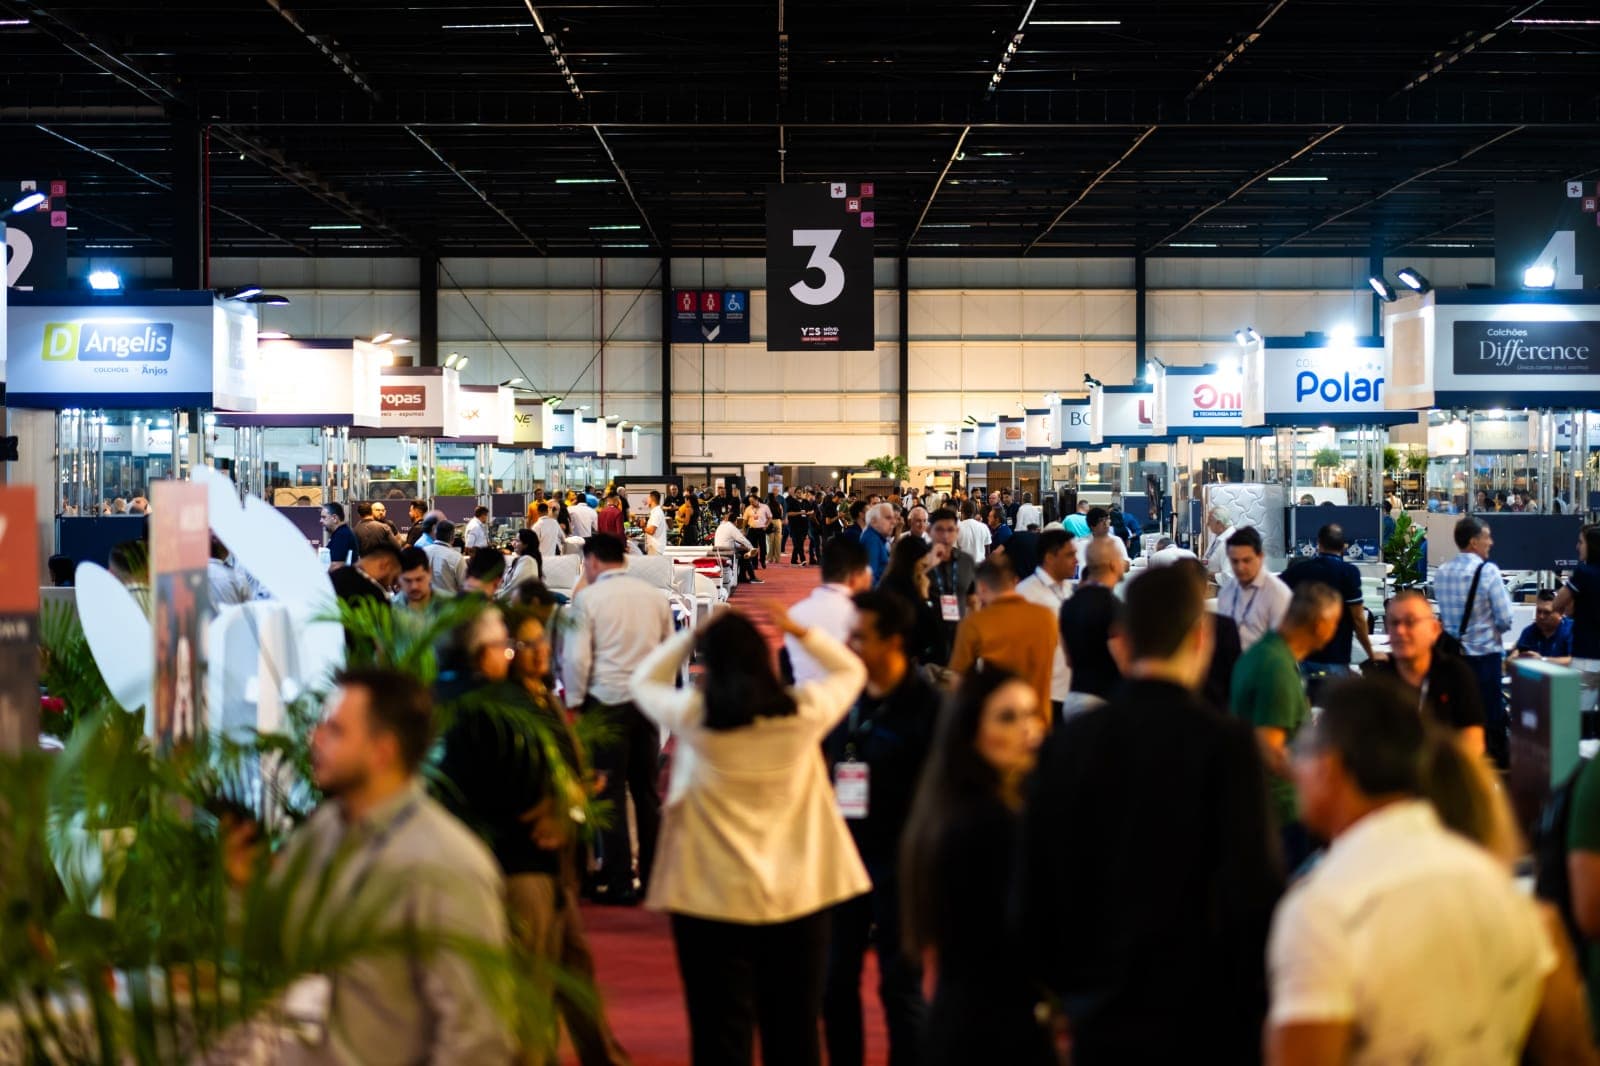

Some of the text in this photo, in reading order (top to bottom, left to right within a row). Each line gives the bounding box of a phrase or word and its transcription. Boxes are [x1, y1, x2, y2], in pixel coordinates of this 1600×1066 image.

[789, 229, 846, 306] 3
[1526, 230, 1583, 290] 4
[85, 327, 167, 358] Angelis
[801, 327, 821, 336] YES
[1487, 328, 1528, 337] Colchões
[1480, 339, 1589, 366] Difference
[1296, 371, 1384, 402] Polar
